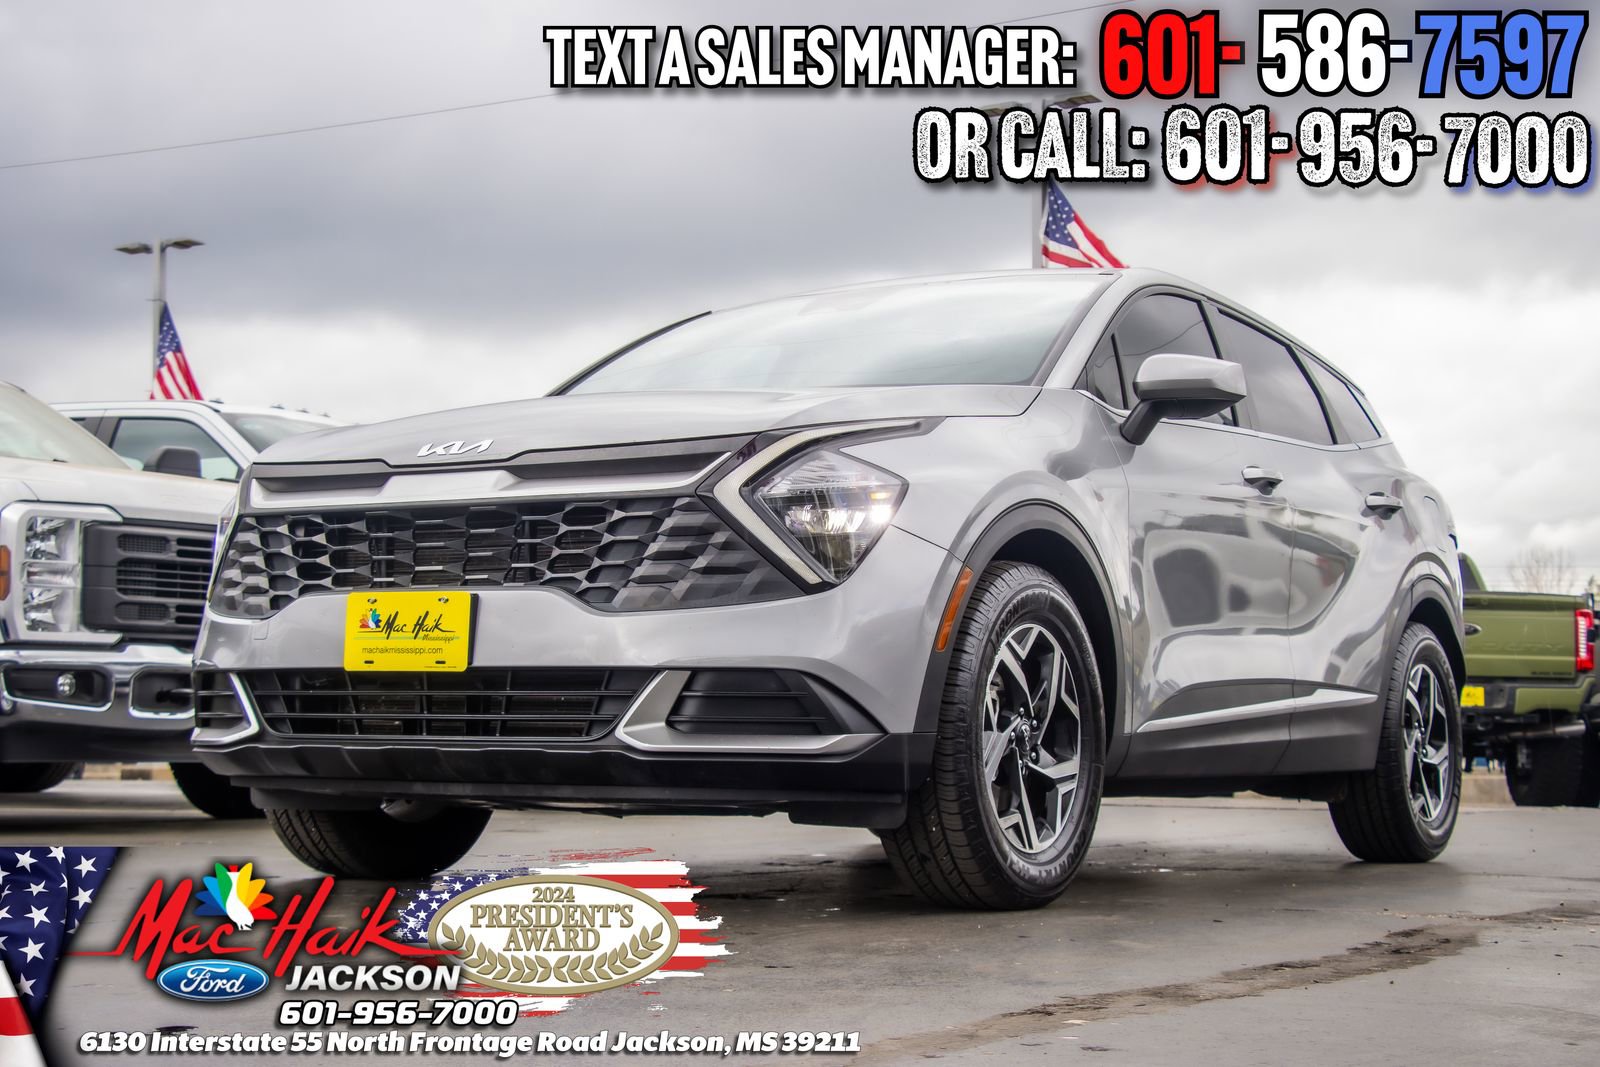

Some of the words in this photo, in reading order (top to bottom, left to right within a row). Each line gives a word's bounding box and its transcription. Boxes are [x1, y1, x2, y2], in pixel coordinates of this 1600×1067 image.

[416, 439, 495, 458] KIA
[382, 610, 407, 640] Mac
[411, 610, 456, 640] Haik
[361, 646, 443, 655] machaikmississippi.com
